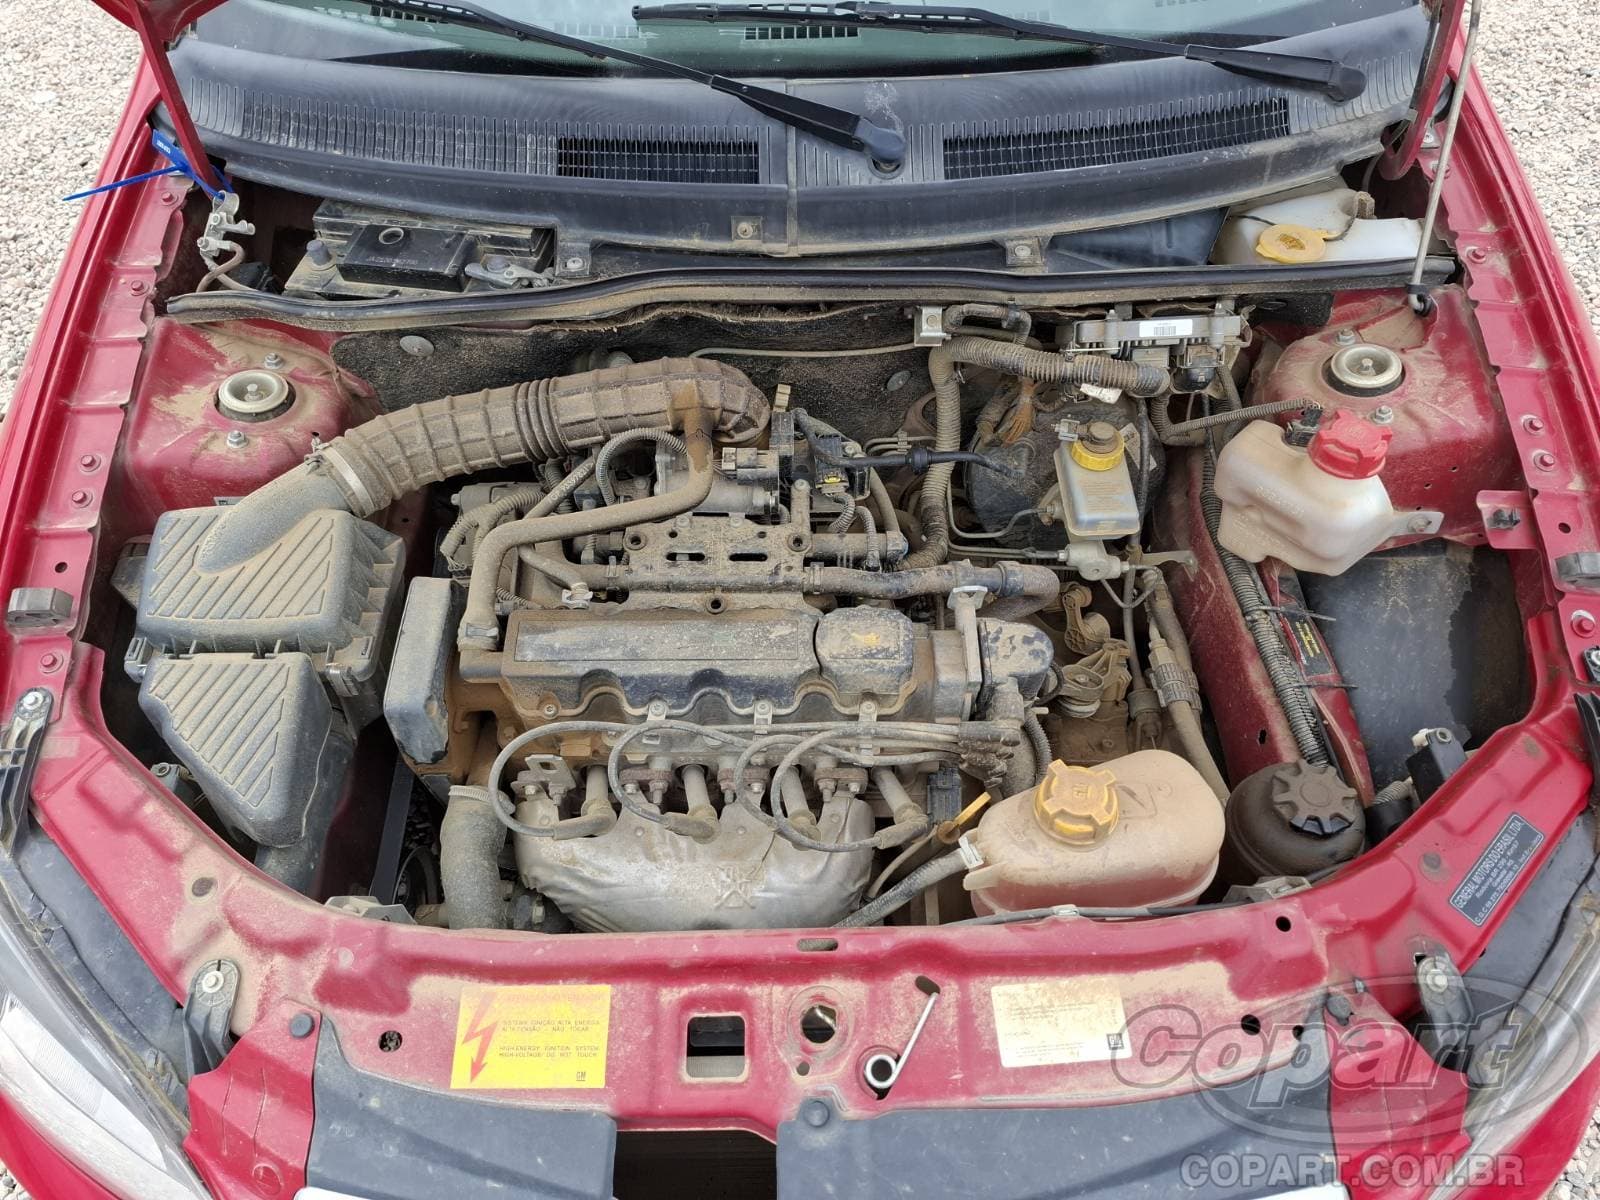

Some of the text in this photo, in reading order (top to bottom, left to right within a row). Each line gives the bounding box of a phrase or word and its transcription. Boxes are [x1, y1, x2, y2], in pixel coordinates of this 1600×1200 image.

[1454, 880, 1479, 909] GENERAL
[1472, 857, 1496, 884] MOTORS
[576, 1071, 587, 1081] GM
